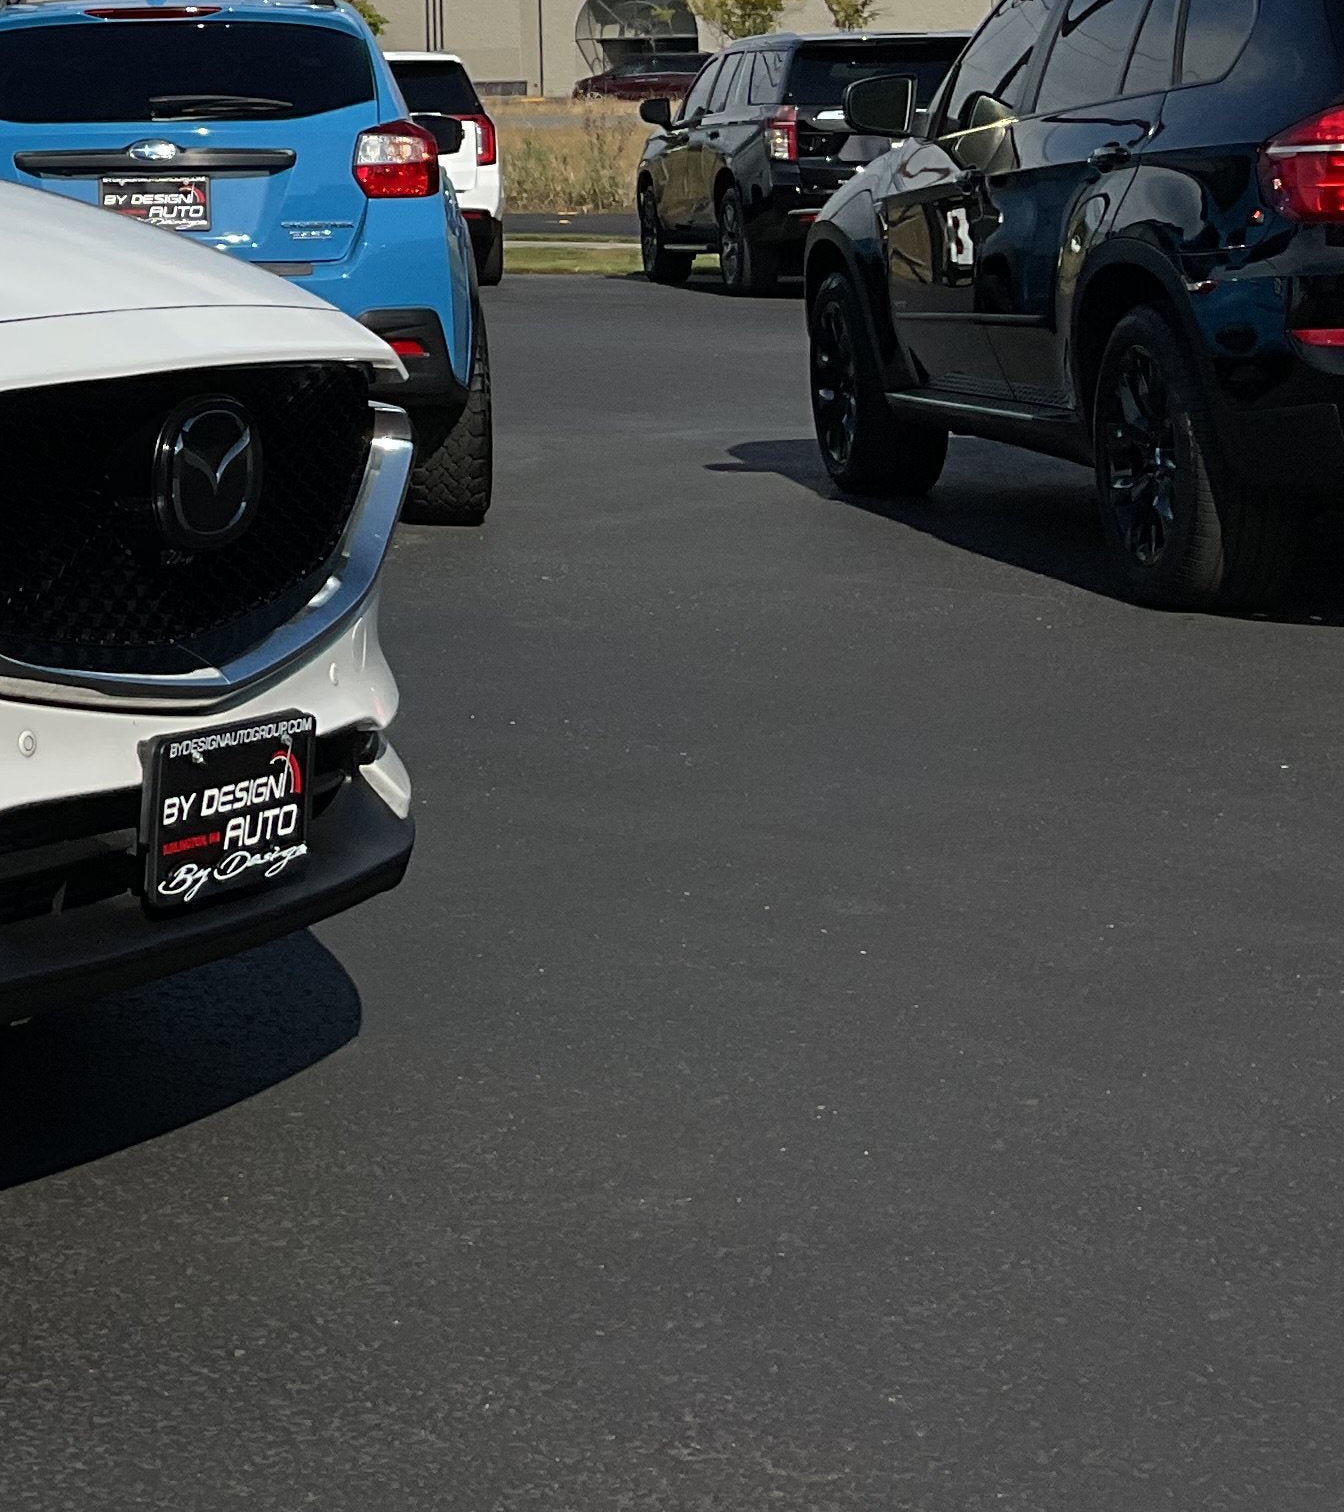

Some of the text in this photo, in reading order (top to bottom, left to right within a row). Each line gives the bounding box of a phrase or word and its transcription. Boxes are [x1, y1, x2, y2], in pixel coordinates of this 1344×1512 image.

[103, 193, 193, 206] BY DESIGN
[148, 205, 204, 218] AUTO
[162, 772, 285, 826] BY DESIGN
[223, 803, 298, 850] AUTO
[157, 863, 212, 902] By
[213, 843, 308, 881] Design
